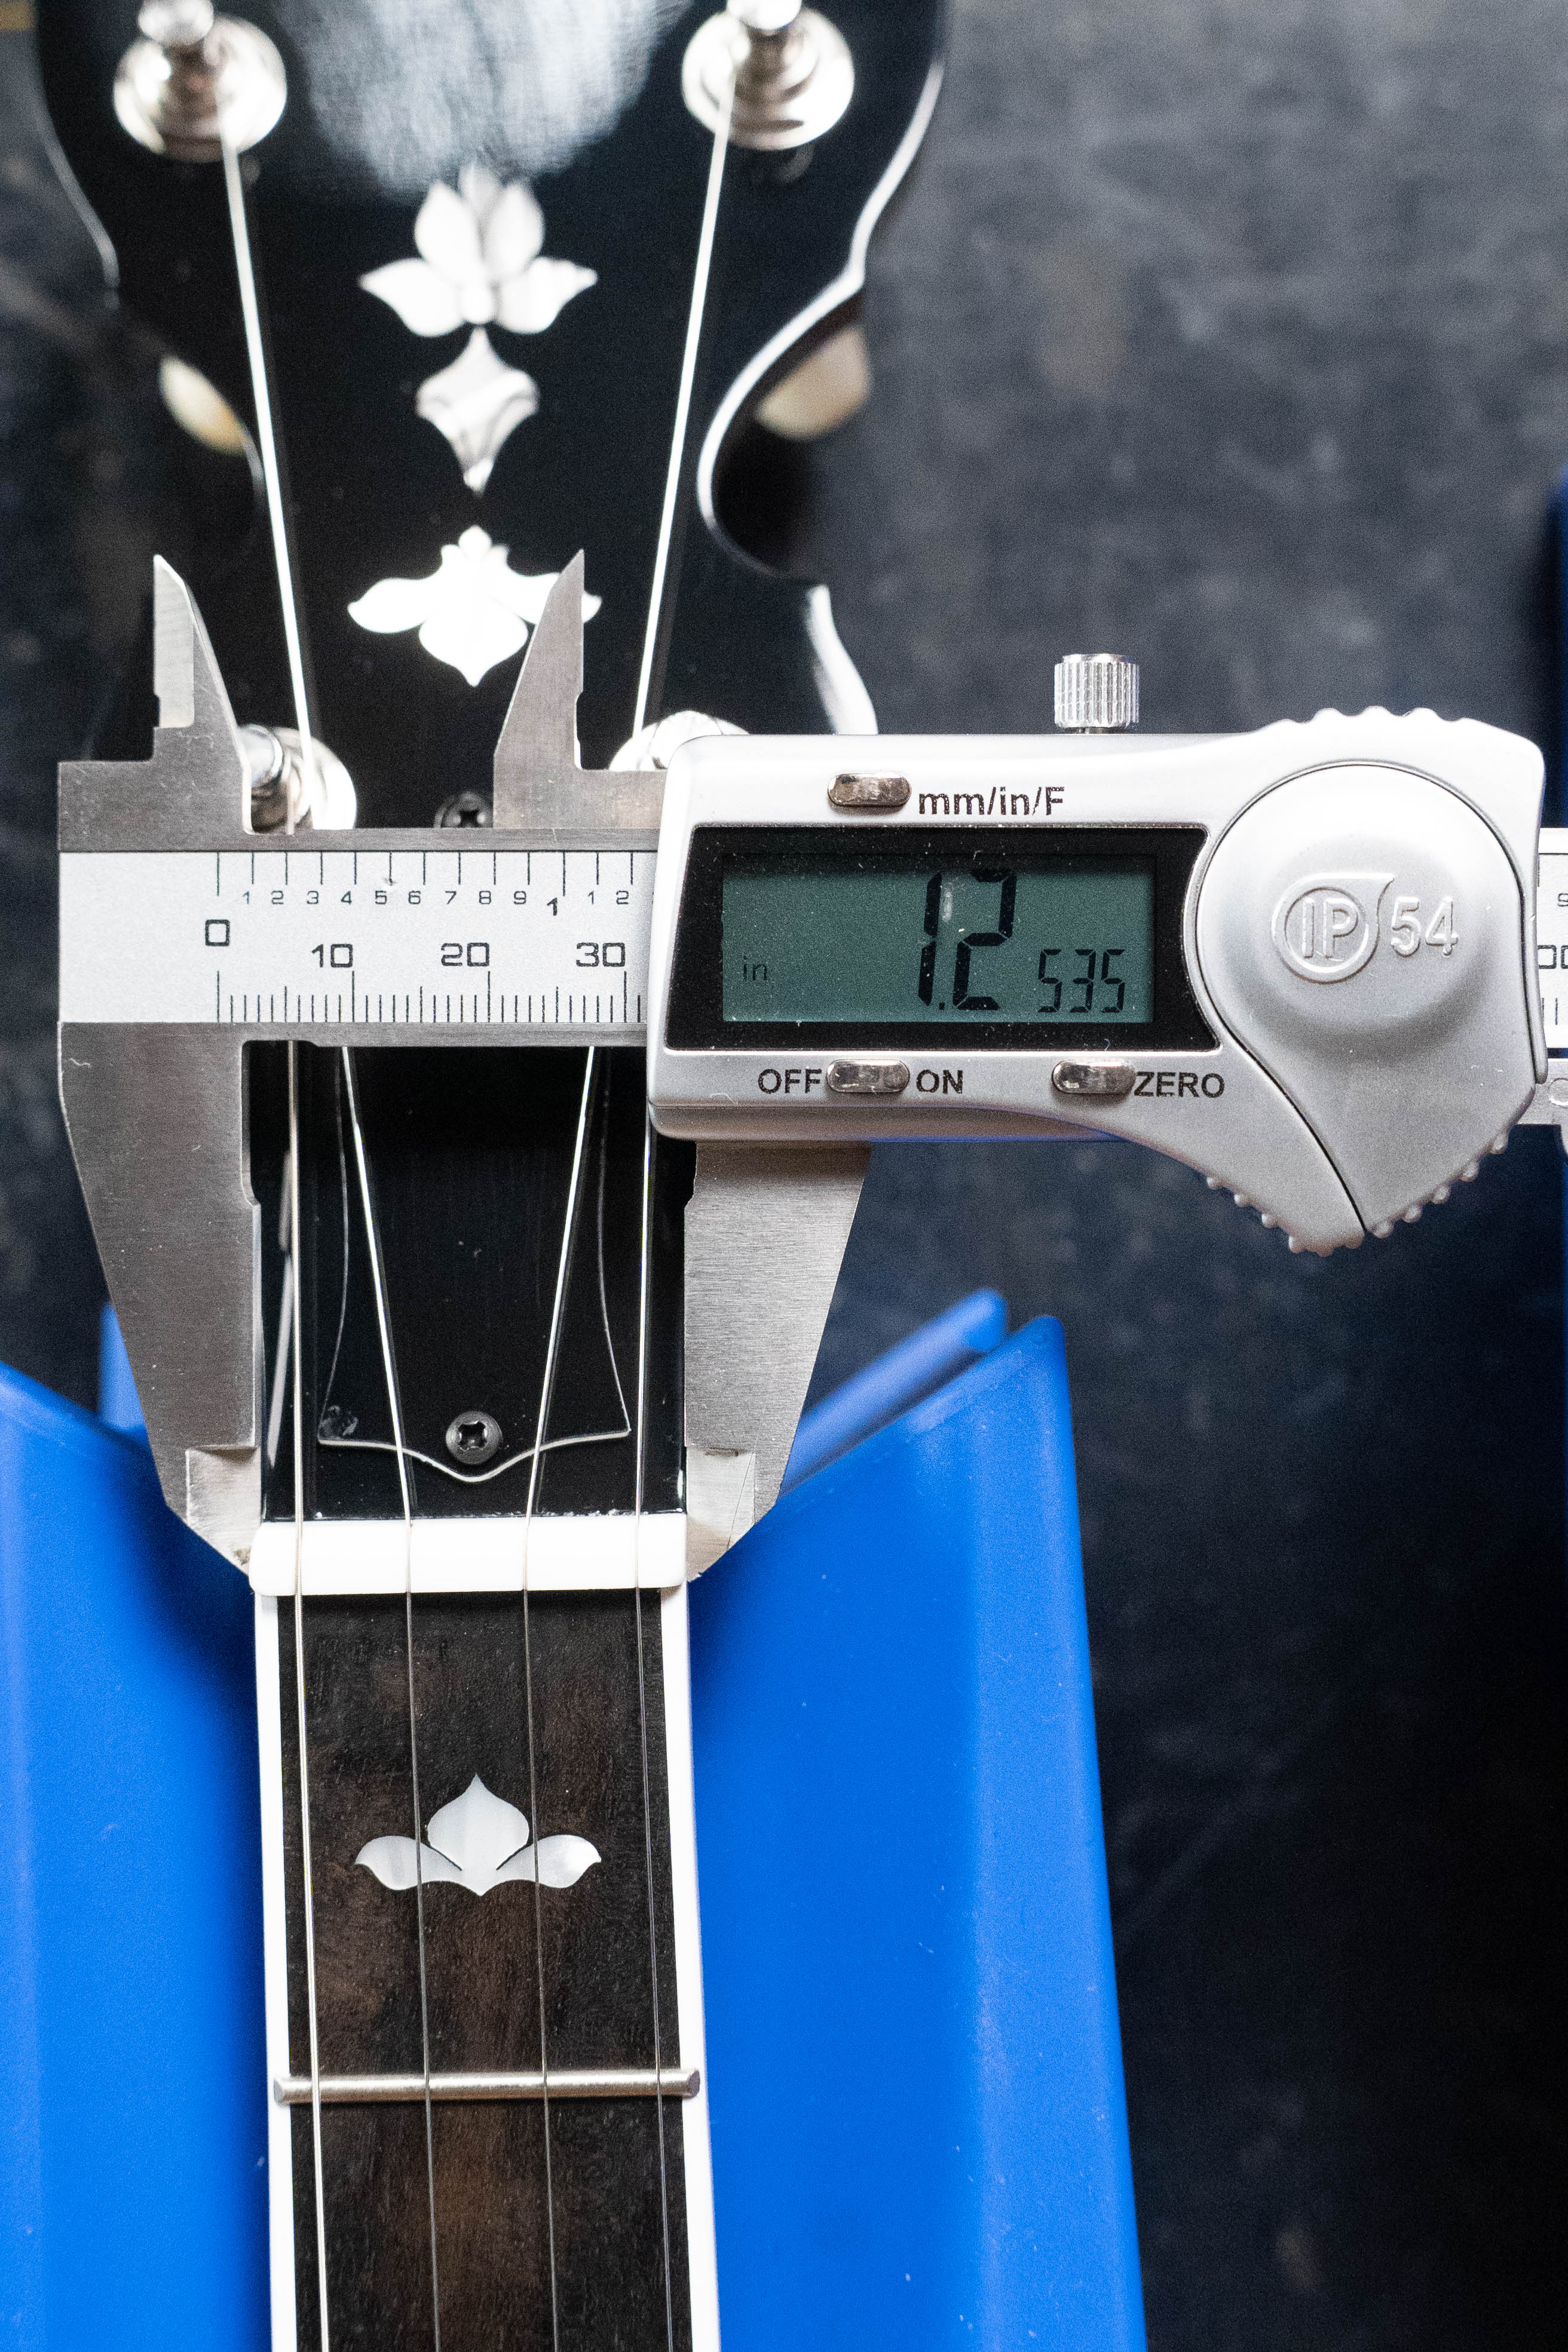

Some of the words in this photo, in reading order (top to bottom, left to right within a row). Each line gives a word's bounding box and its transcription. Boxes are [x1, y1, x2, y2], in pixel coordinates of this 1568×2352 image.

[918, 786, 1065, 816] mm/in/F
[242, 890, 250, 905] 1
[271, 890, 284, 905] 2
[306, 890, 319, 905] 3
[340, 890, 352, 905] 4
[374, 890, 387, 905] 5
[408, 890, 421, 905] 6
[445, 890, 457, 905] 7
[479, 890, 492, 905] 8
[513, 890, 526, 905] 9
[547, 898, 558, 916] 1
[587, 890, 596, 905] 1
[615, 890, 629, 905] 2
[204, 919, 230, 947] 0
[1301, 897, 1359, 959] IP
[1390, 896, 1459, 956] 54
[311, 943, 354, 968] 10
[440, 942, 490, 967] 20
[575, 942, 626, 968] 30
[743, 954, 768, 981] in
[1038, 949, 1126, 1013] 535
[757, 1068, 823, 1095] OFF
[915, 1069, 964, 1095] ON
[1134, 1070, 1226, 1098] ZERO
